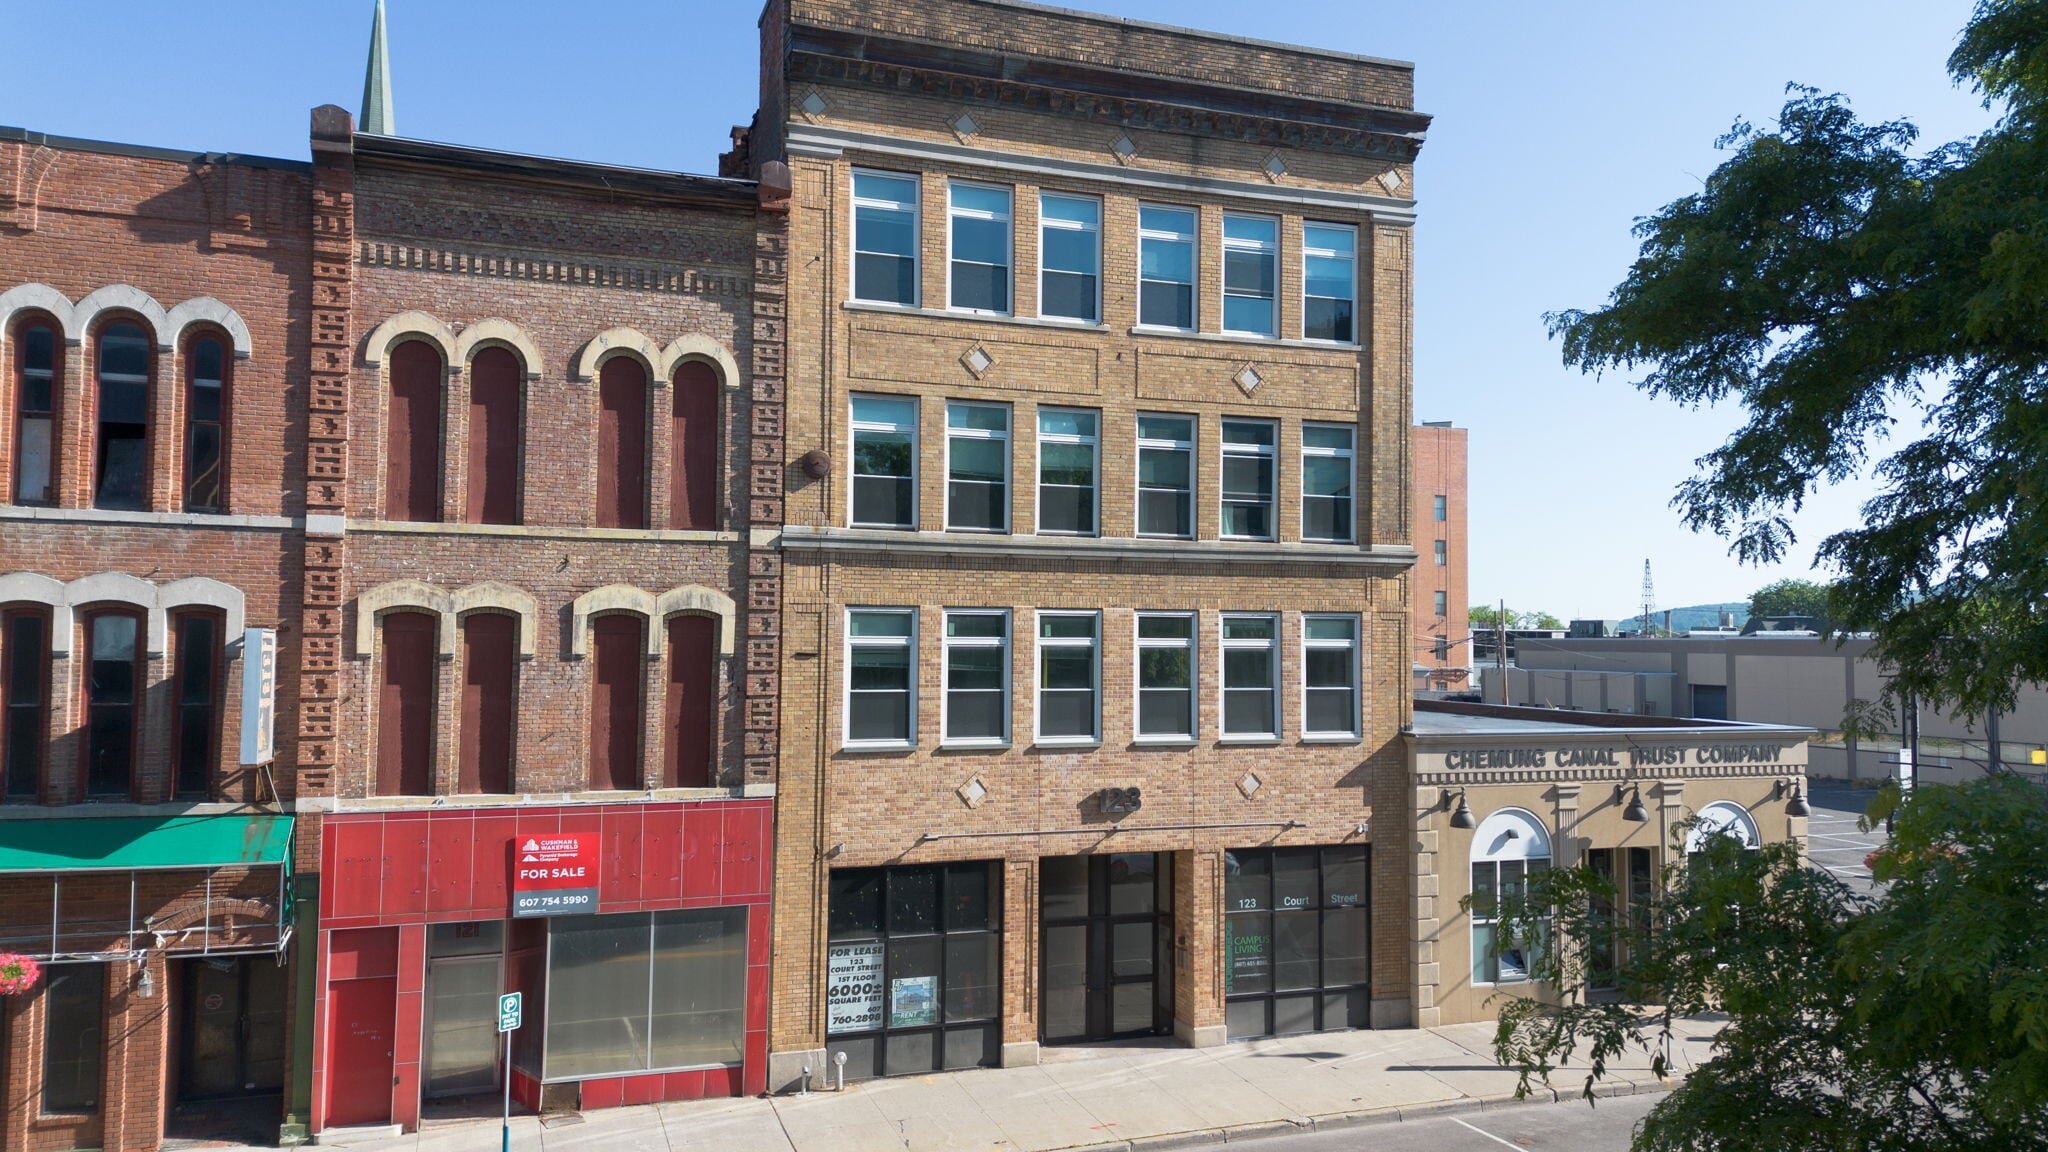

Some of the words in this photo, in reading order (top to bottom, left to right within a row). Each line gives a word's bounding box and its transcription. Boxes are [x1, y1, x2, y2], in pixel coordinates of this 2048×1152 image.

[1445, 749, 1546, 769] CHEMUNG
[1555, 748, 1619, 767] CANAL
[1628, 745, 1688, 766] TRUST
[1696, 745, 1783, 764] COMPANY
[1099, 786, 1142, 812] 123
[520, 869, 548, 879] FOR
[552, 867, 585, 878] SALE
[519, 898, 539, 907] 607
[542, 897, 560, 906] 754
[563, 895, 588, 904] 5990
[1239, 898, 1257, 909] 123
[1284, 896, 1310, 906] Court
[1331, 894, 1358, 903] Street
[1234, 936, 1270, 945] CAMPUS
[830, 949, 850, 957] FOR
[854, 946, 883, 955] LEASE
[1235, 944, 1263, 953] LIVING
[829, 997, 861, 1005] SQUARE
[832, 1013, 880, 1025] 760-2898
